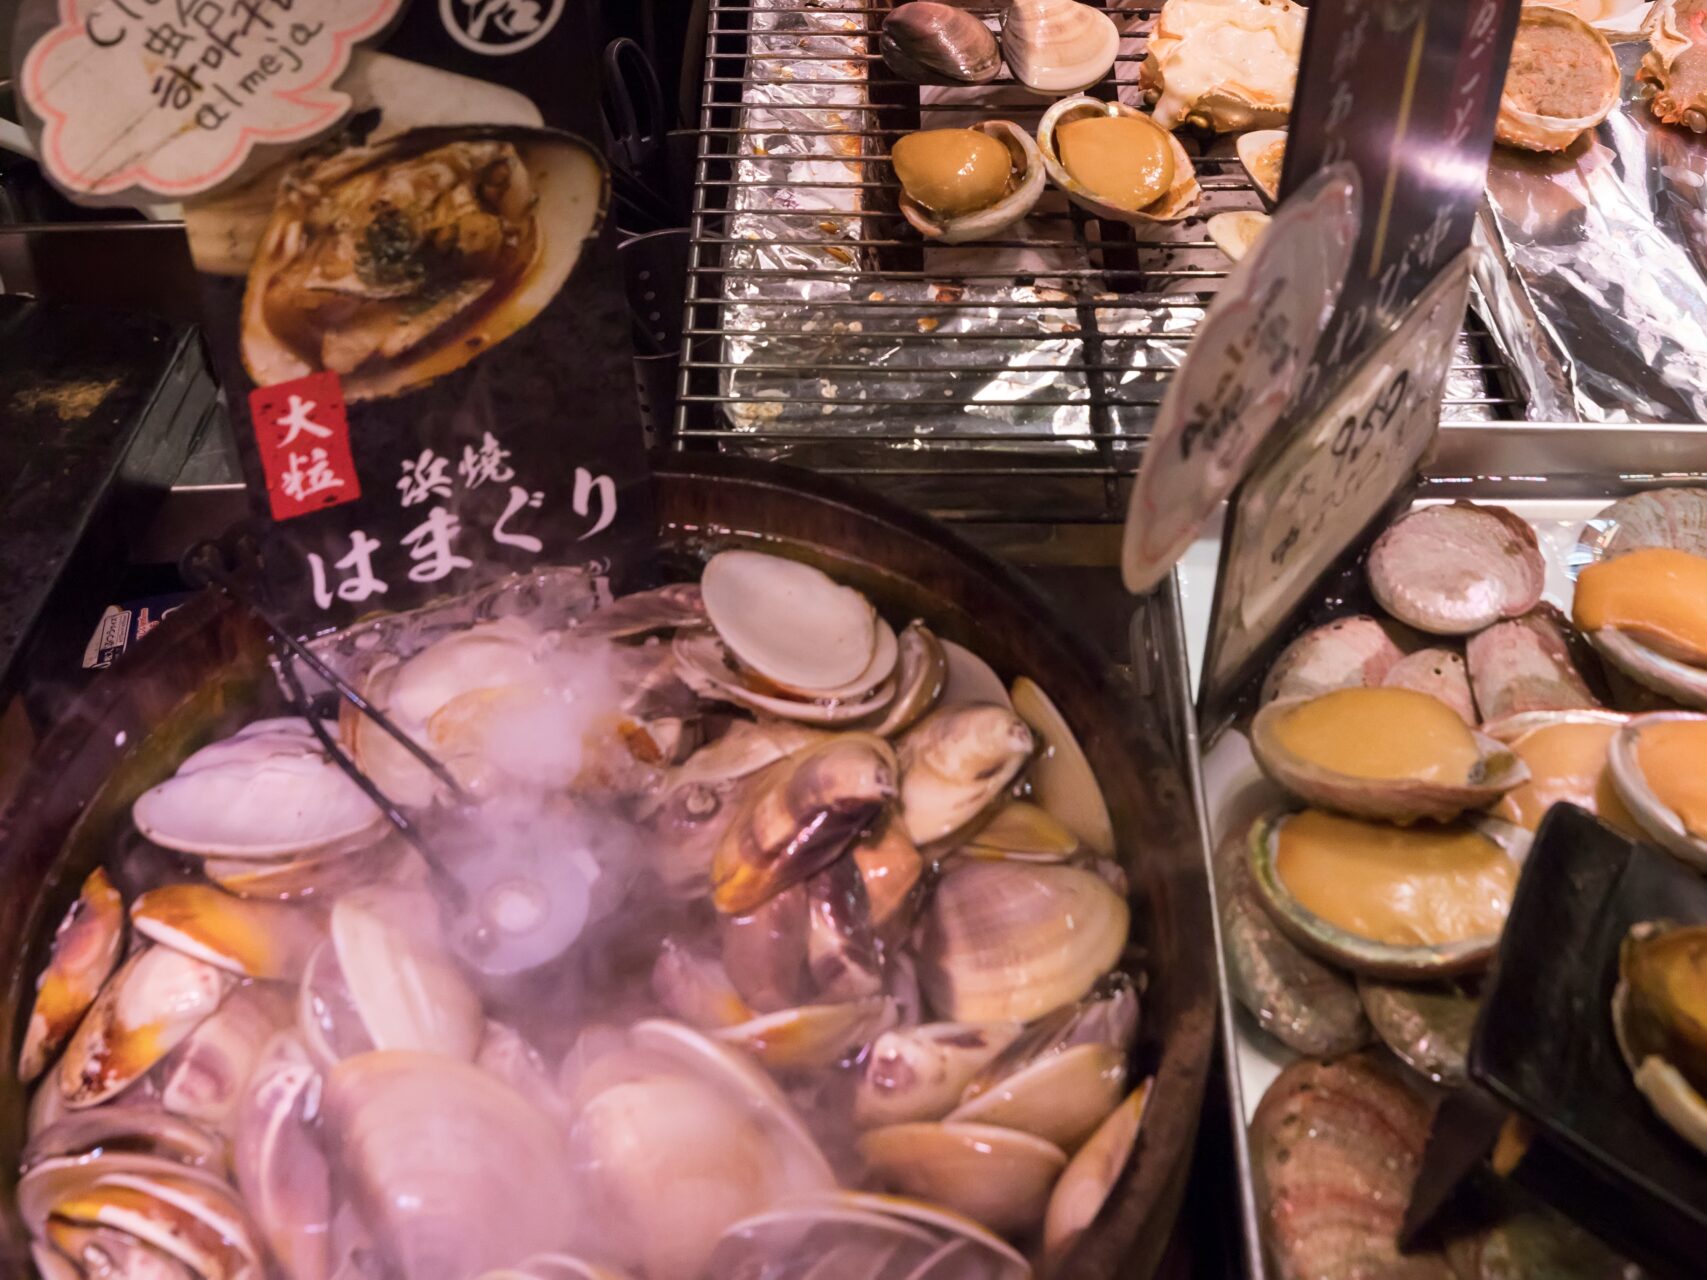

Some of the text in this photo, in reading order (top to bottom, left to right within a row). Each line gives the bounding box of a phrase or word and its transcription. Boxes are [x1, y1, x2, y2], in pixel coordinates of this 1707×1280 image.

[194, 22, 325, 131] almeja
[274, 394, 346, 503] 大粒
[395, 431, 516, 508] 浜焼
[307, 466, 618, 610] はまぐり
